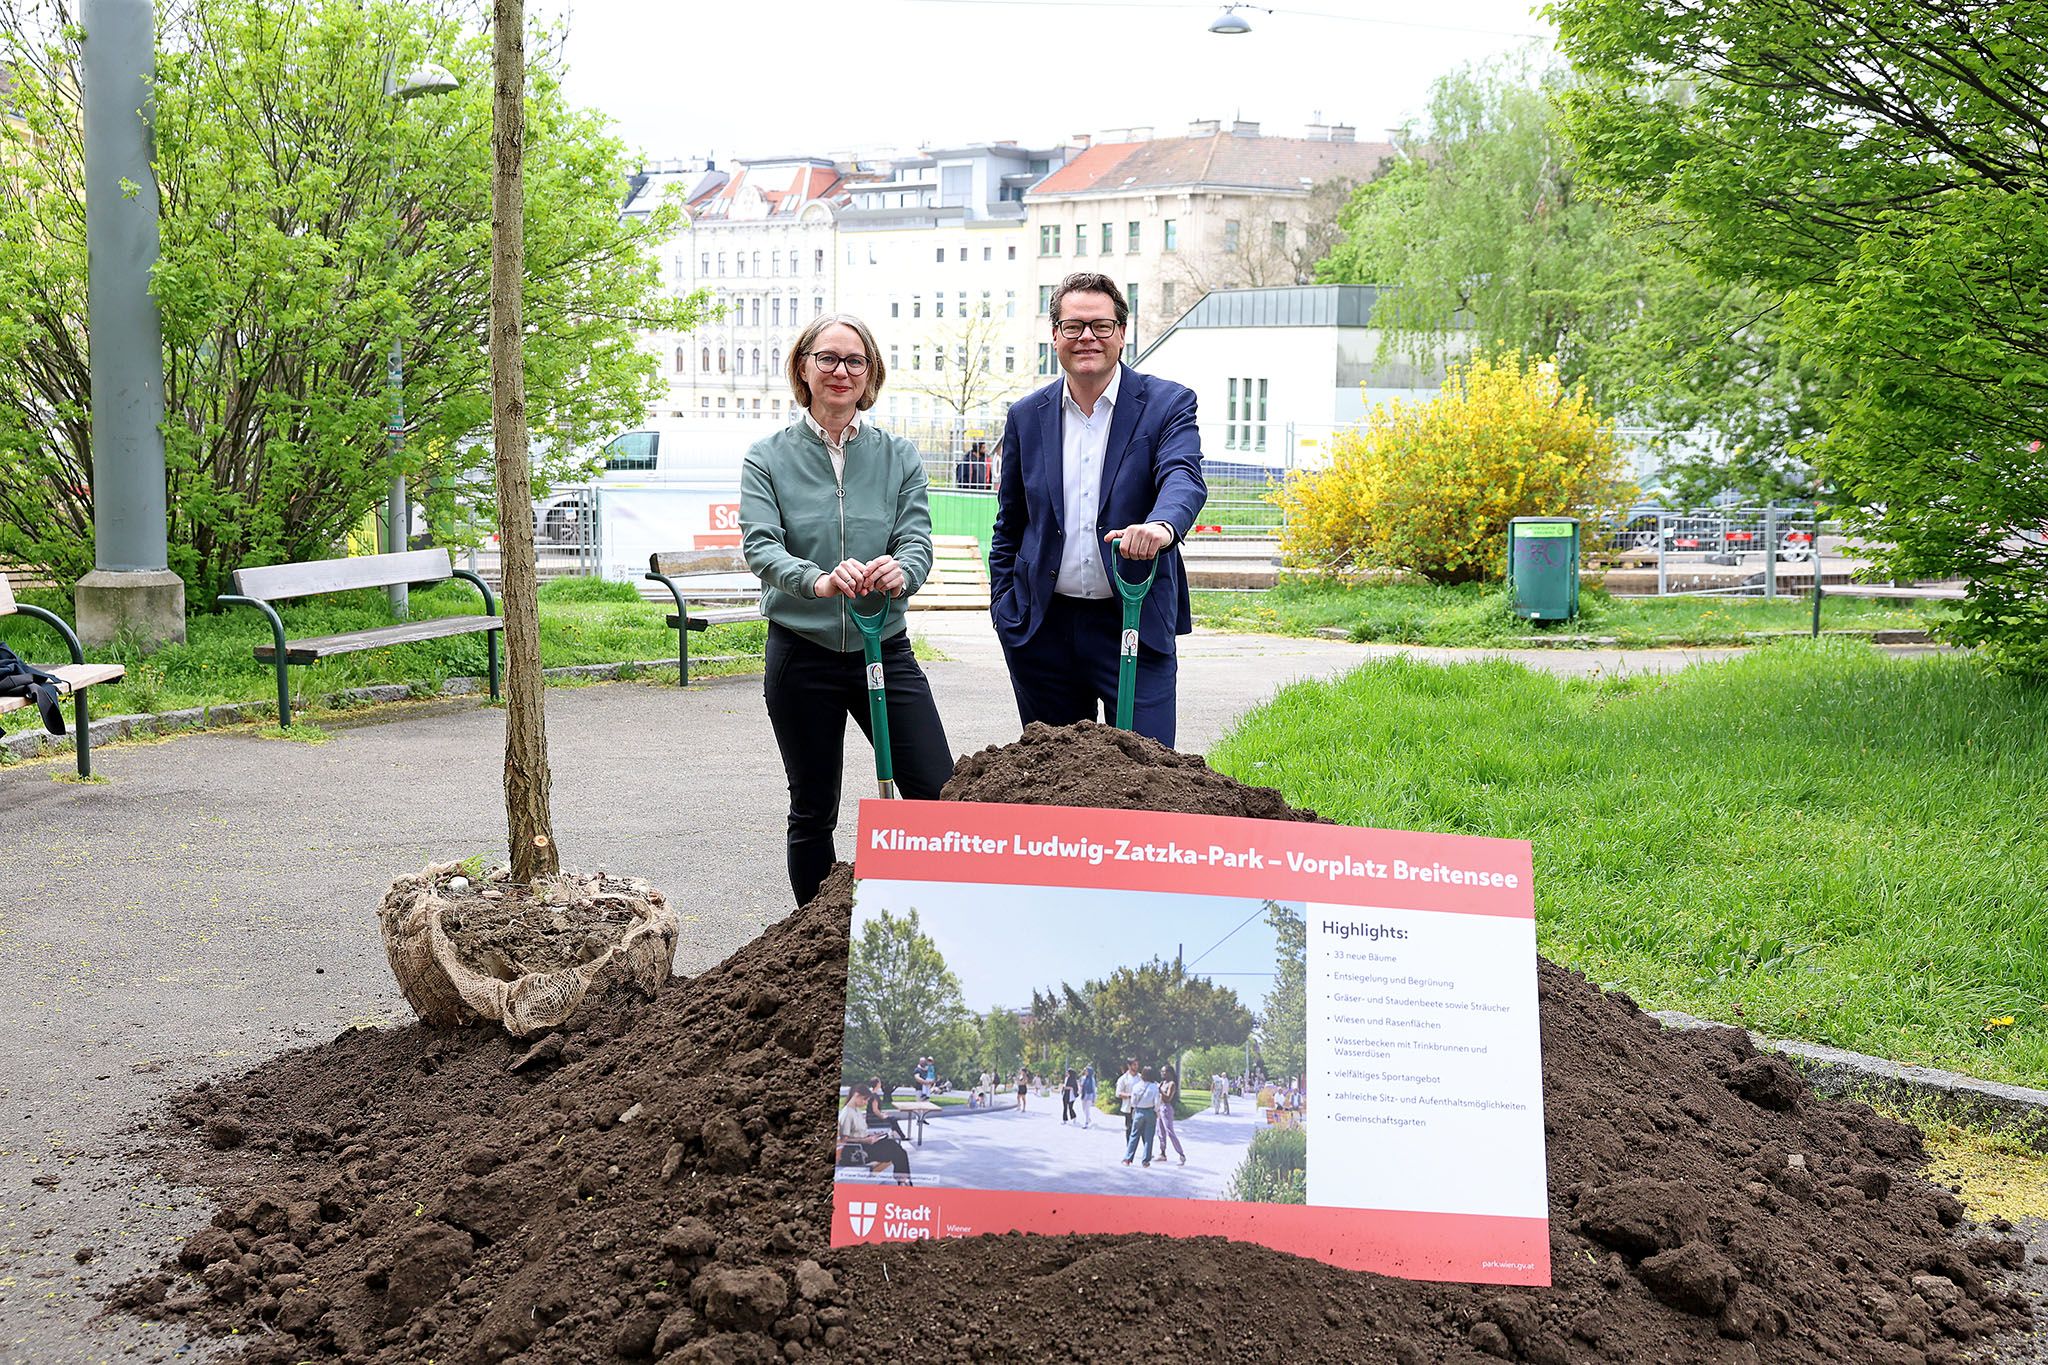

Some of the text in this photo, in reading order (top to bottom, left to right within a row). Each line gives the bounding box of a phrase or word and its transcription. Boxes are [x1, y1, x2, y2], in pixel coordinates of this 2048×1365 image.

[871, 828, 1008, 856] Klimafitter
[1013, 834, 1264, 869] Ludwig-Zatzka-Park
[1286, 851, 1388, 881] Vorplatz
[1393, 860, 1519, 889] Breitensee
[1323, 921, 1408, 941] Highlights:
[1334, 951, 1397, 963] 33 neue Bäume
[1334, 972, 1455, 989] Entsiegelung und Begrünung
[1334, 993, 1510, 1012] Gräser- und Staudenbeete sowie Sträucher
[1334, 1015, 1441, 1029] Wiesen und Rasenflächen
[1335, 1037, 1488, 1054] Wasserbecken mit Trinkbrunnen und
[1335, 1048, 1390, 1059] Wasserdüsen
[1335, 1069, 1440, 1084] vielfältiges Sportangebot
[1335, 1092, 1526, 1111] zahlreiche Sitz- und Aufenthaltsmöglichkeiten
[1335, 1113, 1426, 1127] Gemeinschaftsgarten
[884, 1203, 931, 1221] Stadt
[884, 1222, 929, 1239] Wien
[1482, 1260, 1535, 1271] park.wien.gv.at
